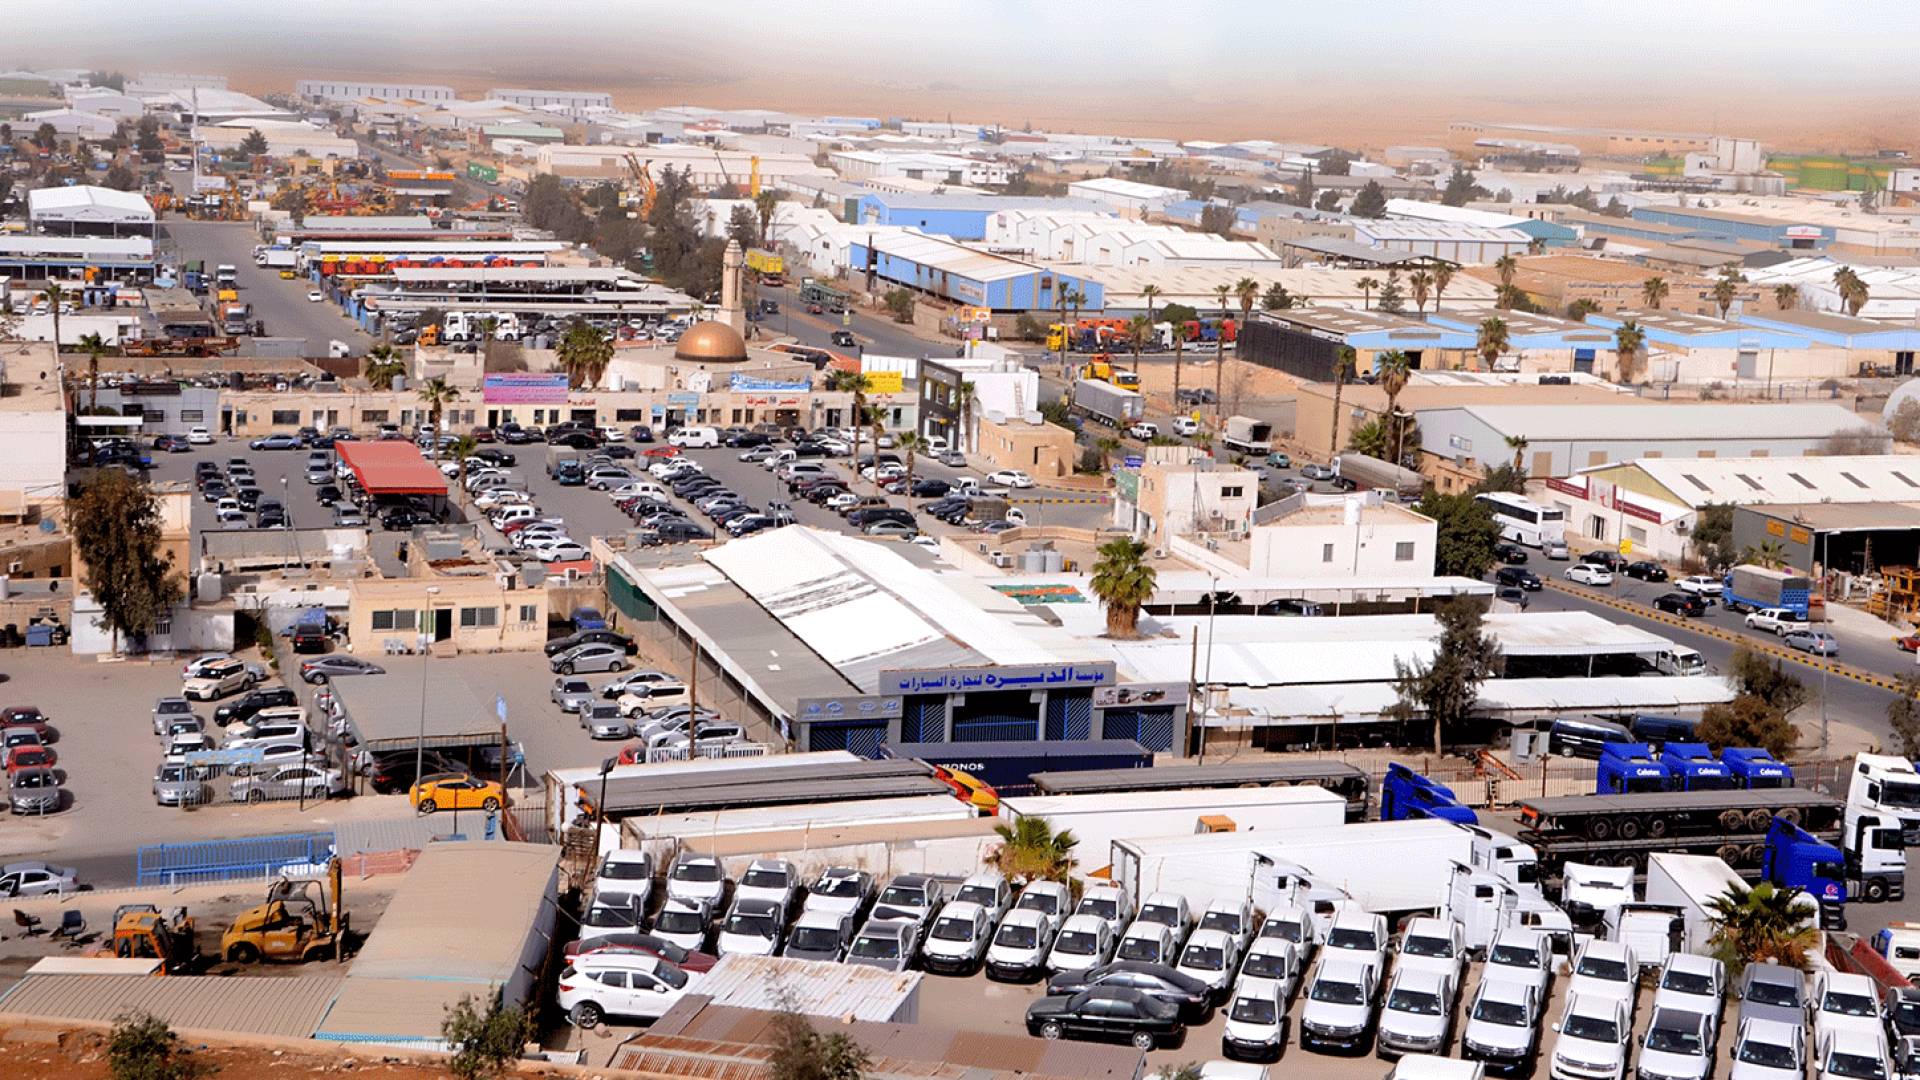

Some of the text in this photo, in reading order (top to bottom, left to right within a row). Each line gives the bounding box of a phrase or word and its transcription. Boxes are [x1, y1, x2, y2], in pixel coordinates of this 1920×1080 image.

[899, 675, 948, 692] السيارات
[949, 673, 983, 690] لتجارة
[1075, 671, 1105, 684] مؤسسة
